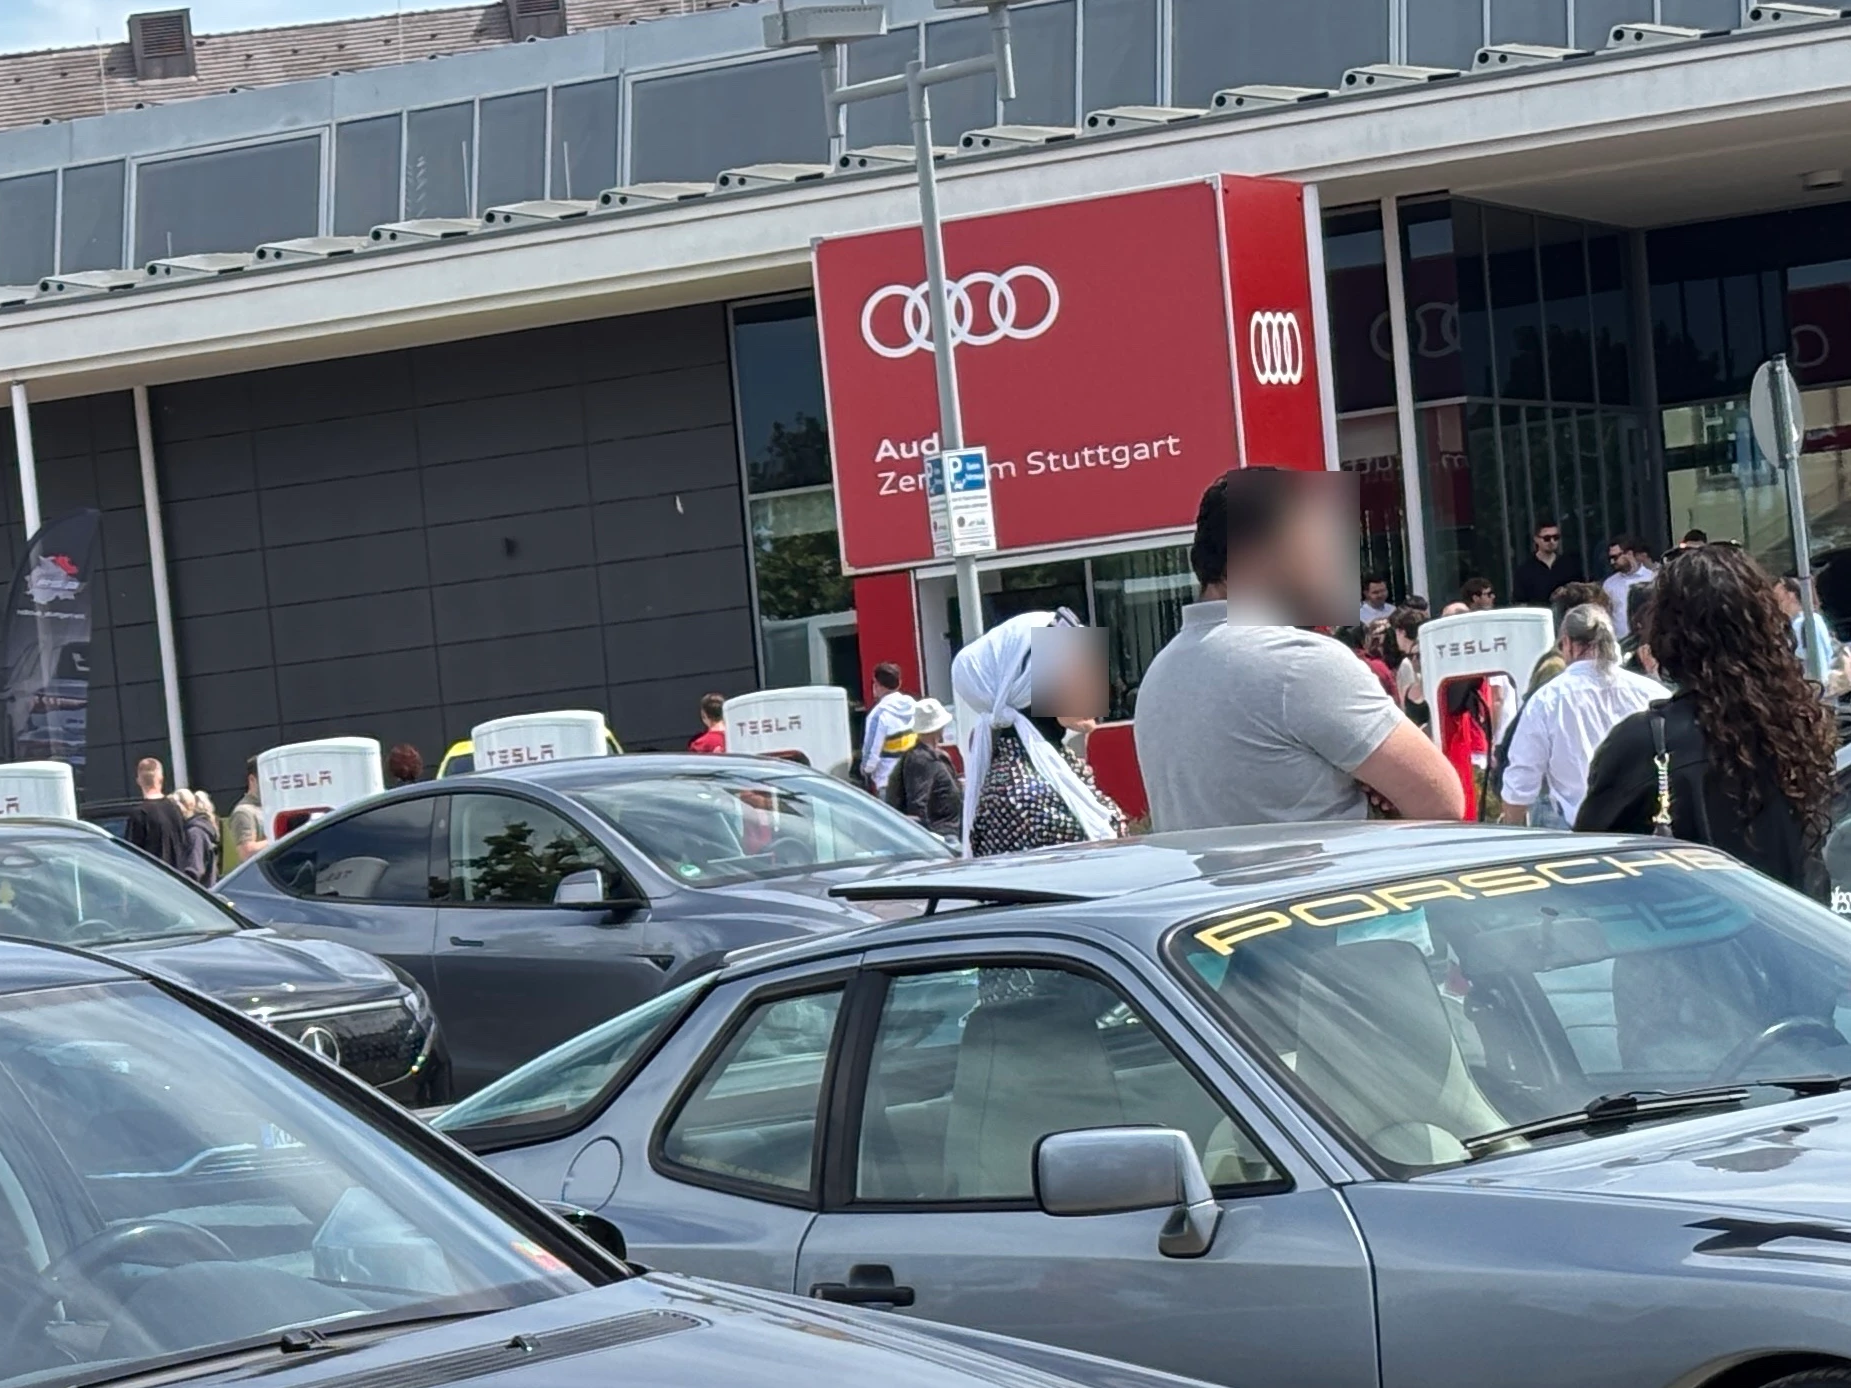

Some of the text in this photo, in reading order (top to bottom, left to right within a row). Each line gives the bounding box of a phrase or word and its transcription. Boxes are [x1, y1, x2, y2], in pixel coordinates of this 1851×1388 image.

[874, 432, 939, 462] Aud
[1026, 434, 1182, 476] Stuttgart
[1436, 637, 1508, 658] TESLA
[736, 715, 802, 737] TESLA
[487, 744, 554, 766] TESLA
[269, 770, 333, 790] TESLA
[1194, 848, 1749, 956] PORSCHE
